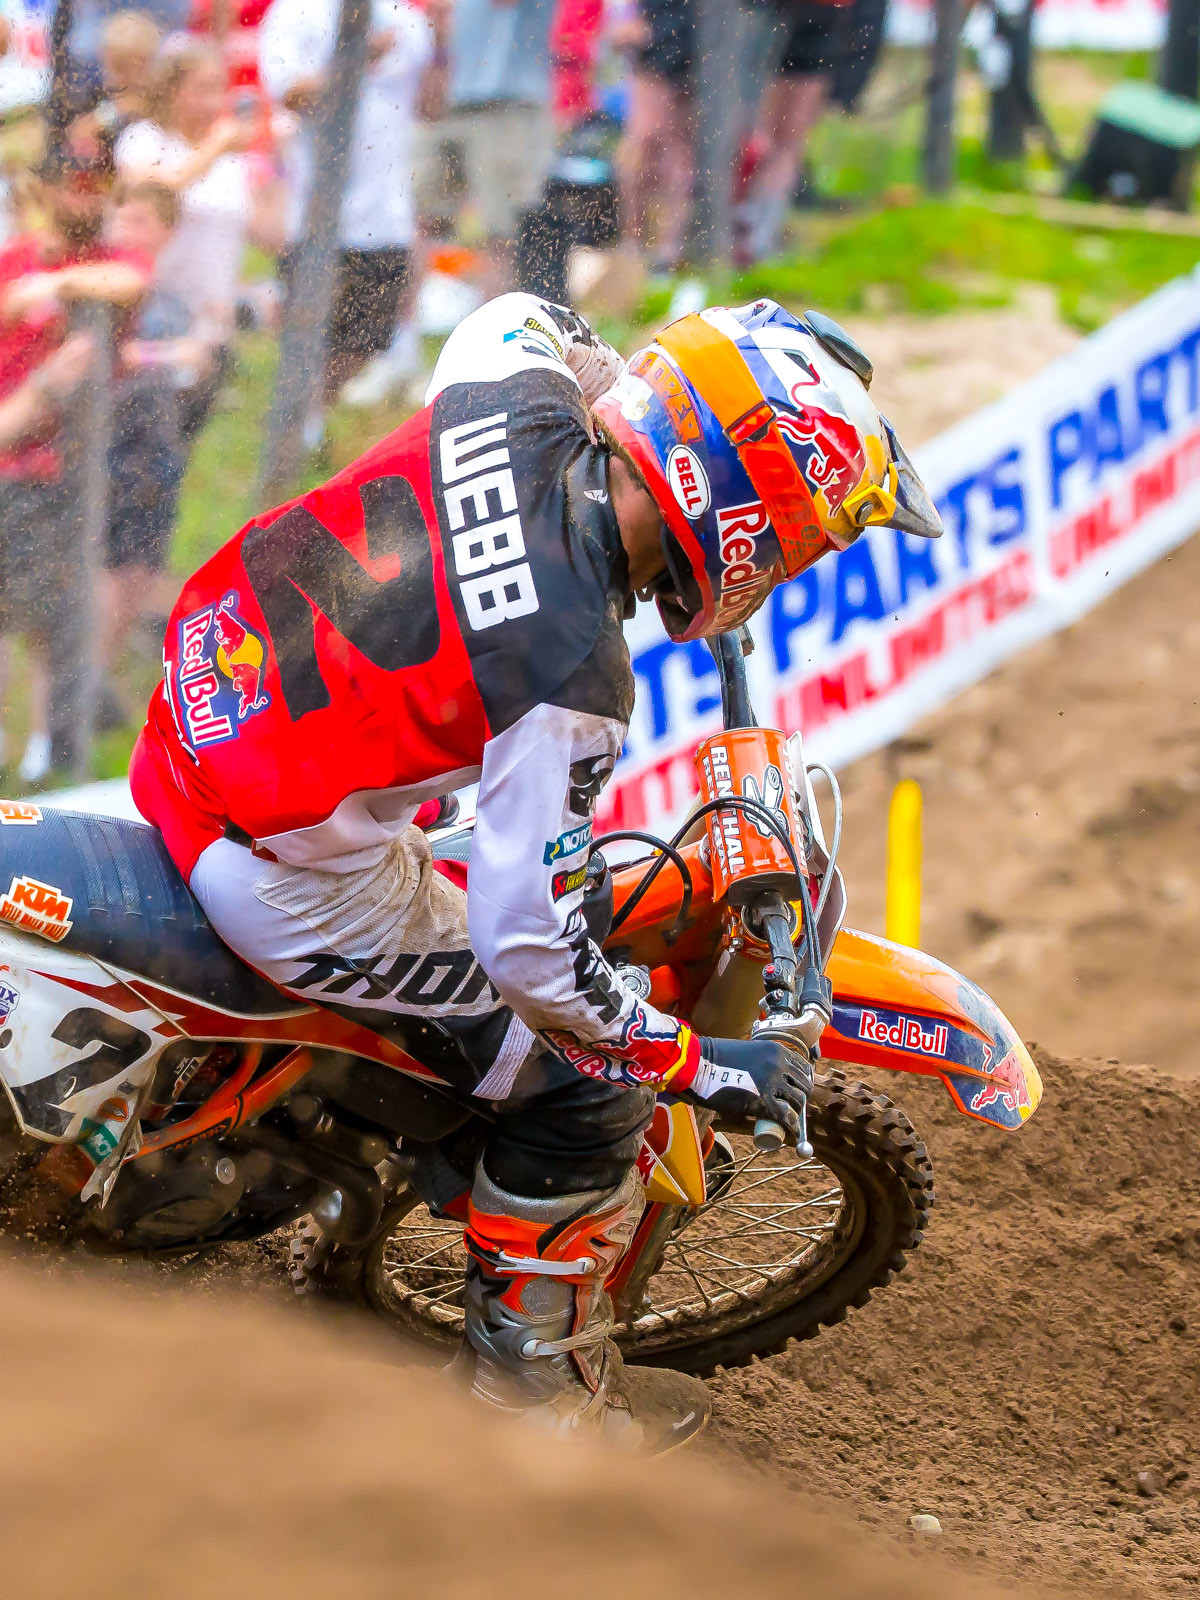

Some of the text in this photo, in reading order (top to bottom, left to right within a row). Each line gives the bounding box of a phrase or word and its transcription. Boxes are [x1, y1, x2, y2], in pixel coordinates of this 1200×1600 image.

[439, 412, 540, 632] WEBB
[675, 456, 702, 513] BELL
[770, 445, 1027, 675] PARTS
[710, 745, 746, 875] RENTHAL
[11, 881, 70, 922] KTM
[10, 1007, 152, 1137] 2
